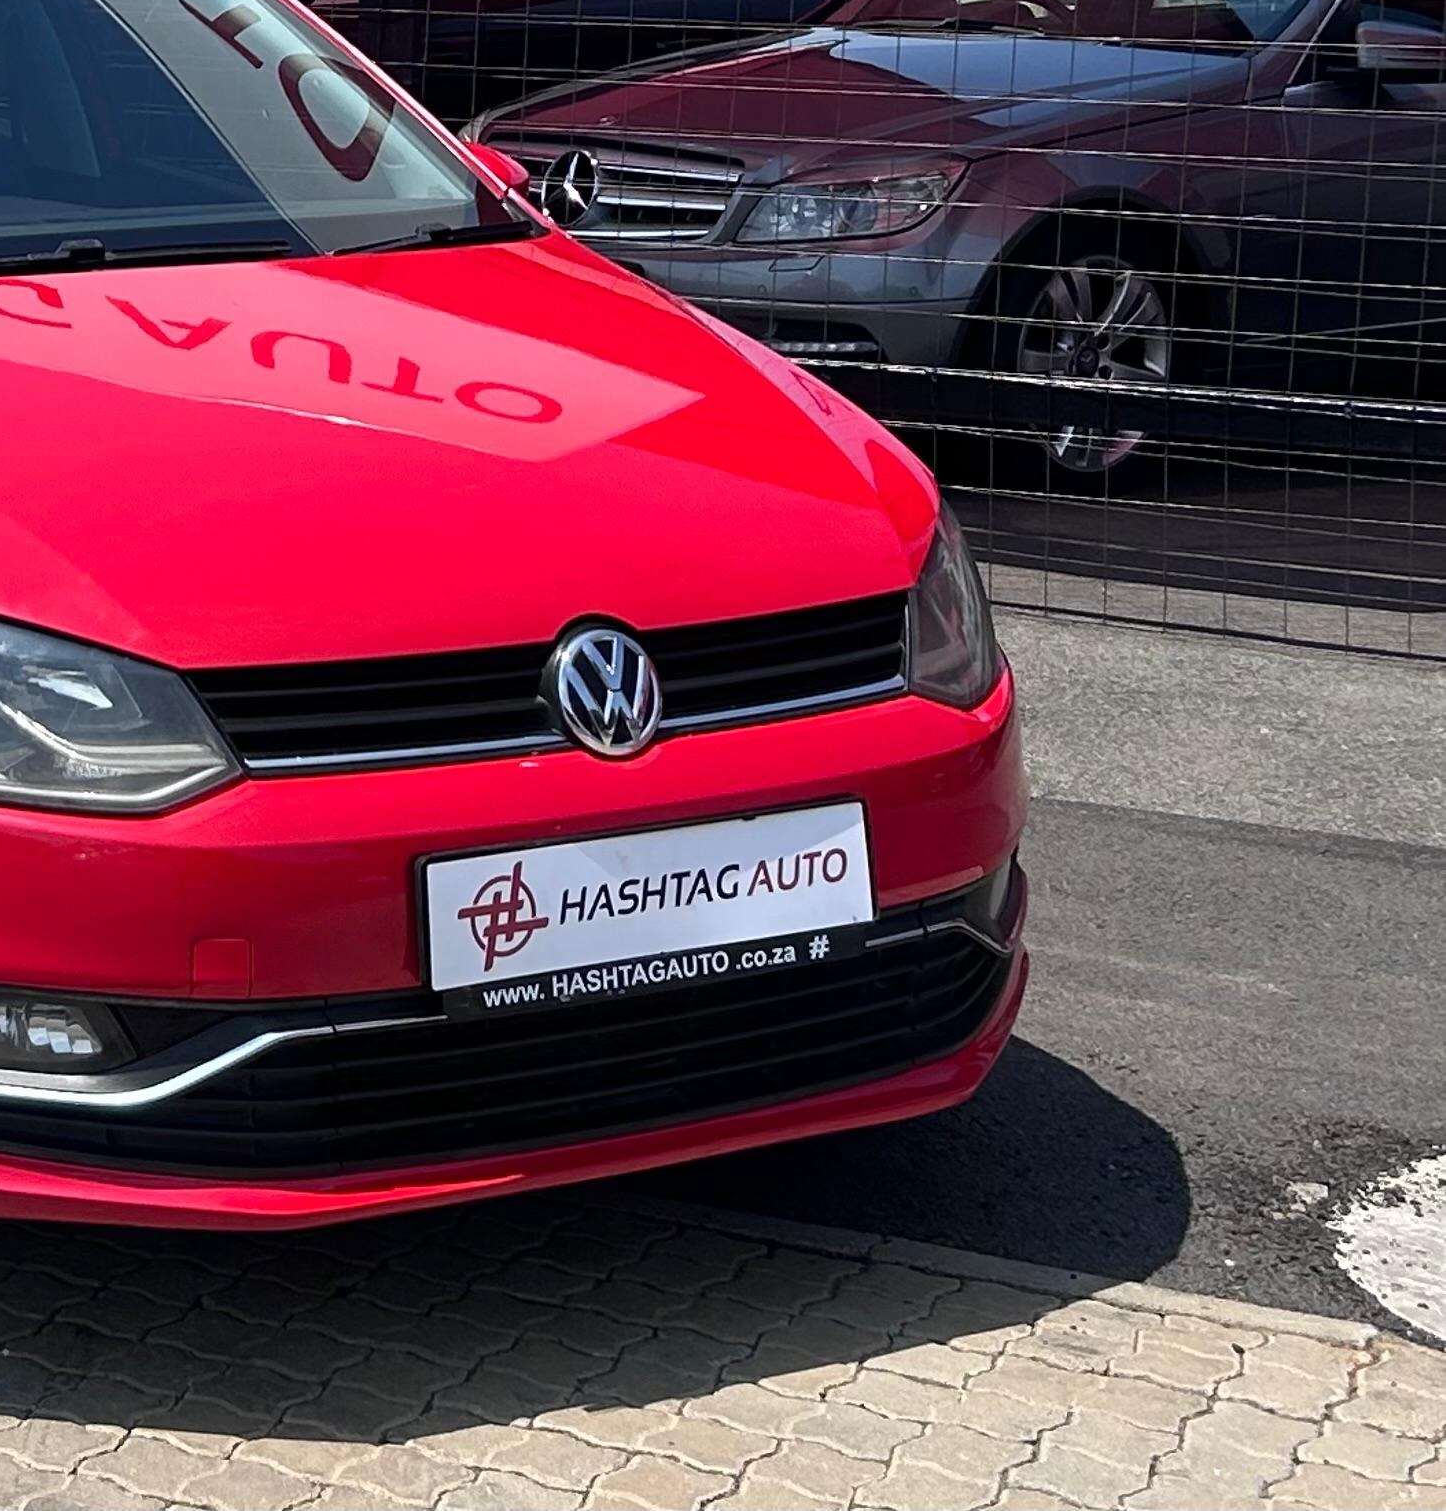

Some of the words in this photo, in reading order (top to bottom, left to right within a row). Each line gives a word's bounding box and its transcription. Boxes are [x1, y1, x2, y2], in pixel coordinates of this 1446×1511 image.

[559, 863, 741, 926] HASHTAG
[747, 847, 848, 896] AUTO
[482, 981, 546, 1009] www.
[552, 951, 729, 999] HASHTAGAUTO
